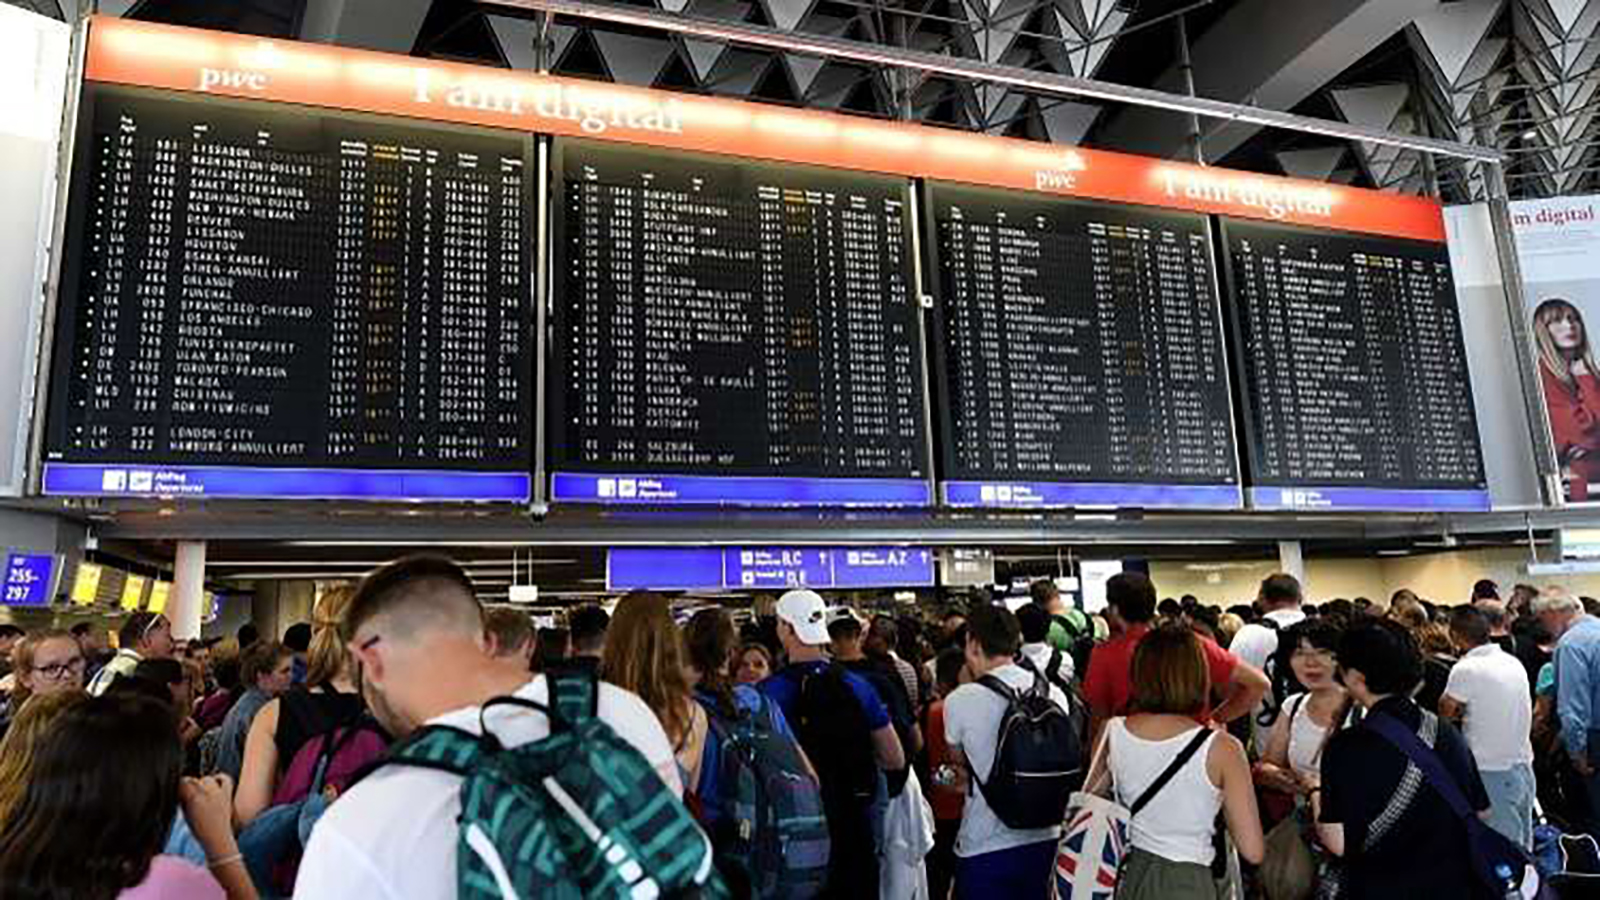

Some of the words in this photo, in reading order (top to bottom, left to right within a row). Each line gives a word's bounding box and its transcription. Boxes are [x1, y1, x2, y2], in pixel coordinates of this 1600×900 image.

[200, 68, 267, 91] pwc
[449, 84, 522, 115] am
[536, 84, 682, 134] digital
[1036, 170, 1075, 190] pwc
[1241, 179, 1332, 218] digital
[1536, 205, 1594, 226] digital
[6, 585, 30, 600] 297
